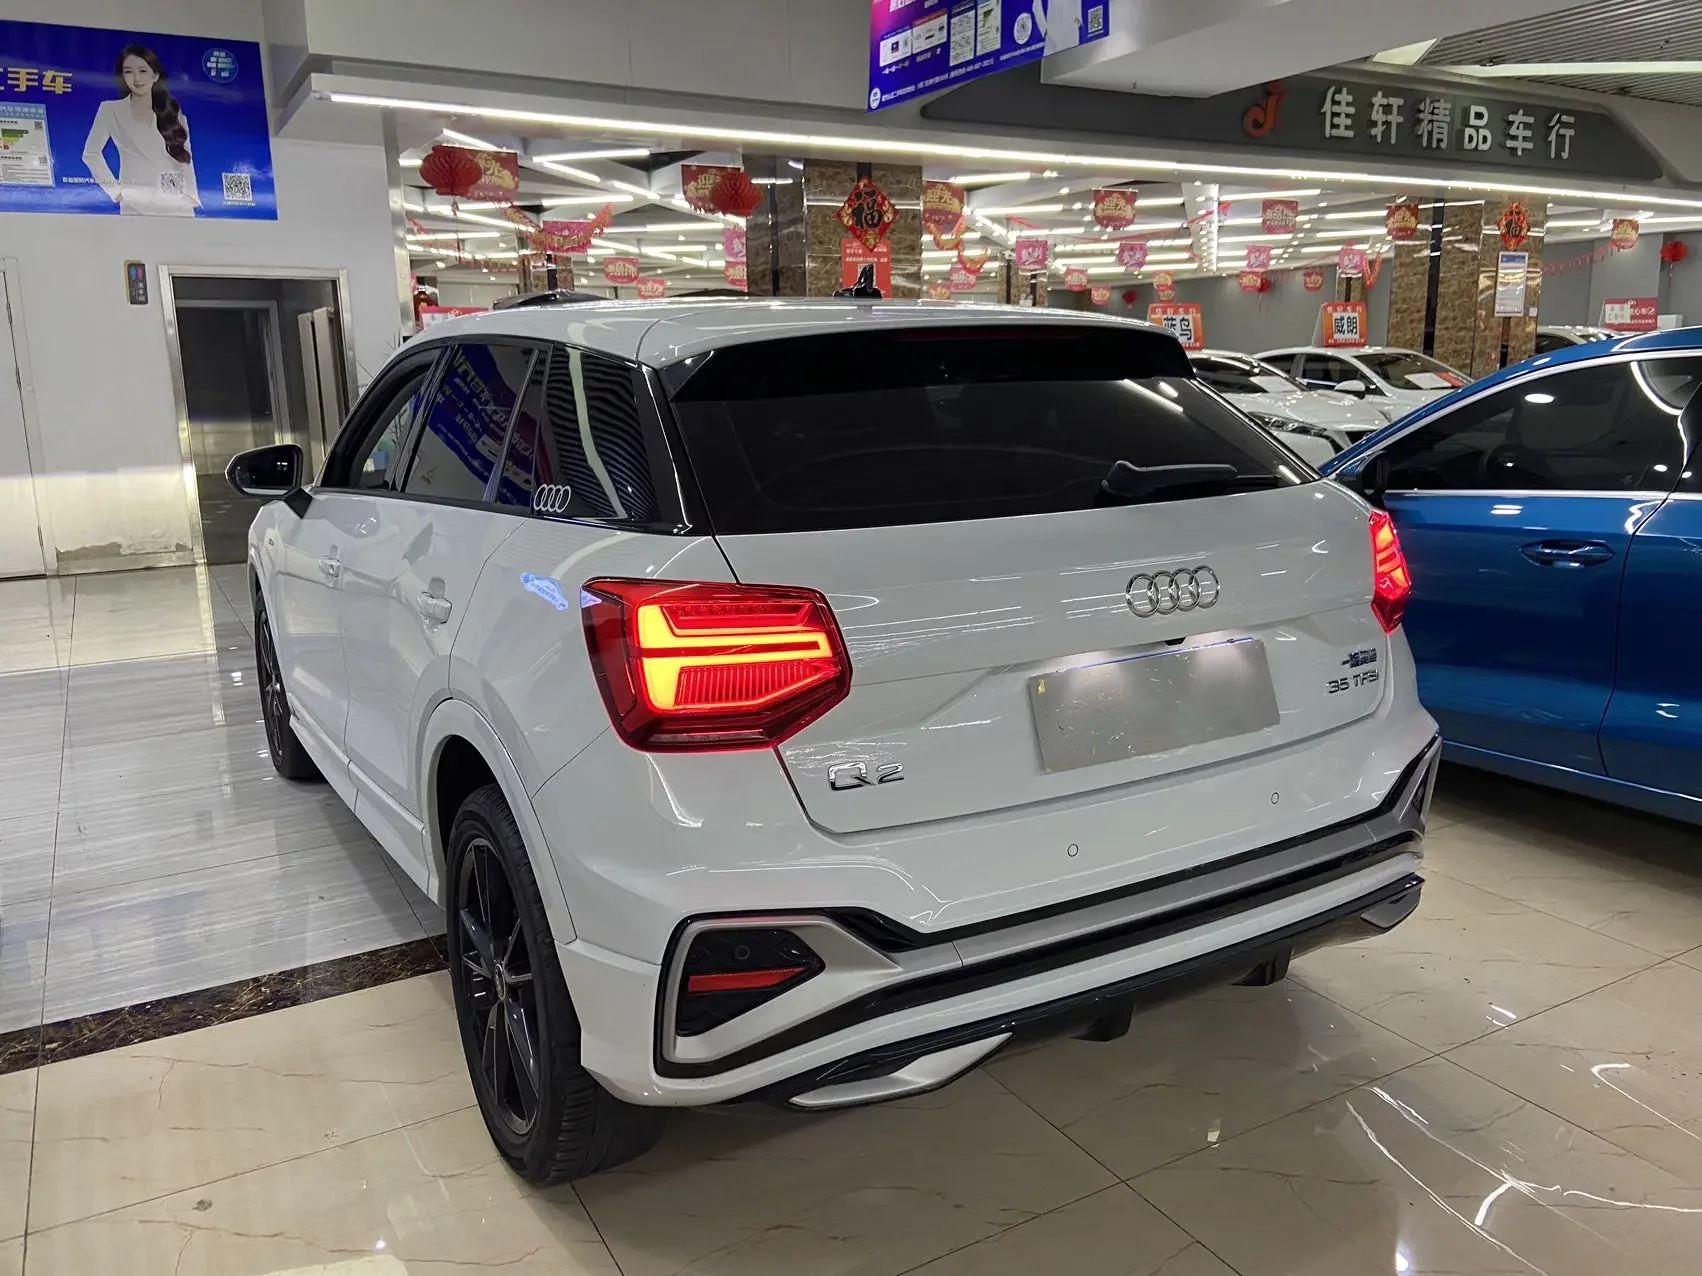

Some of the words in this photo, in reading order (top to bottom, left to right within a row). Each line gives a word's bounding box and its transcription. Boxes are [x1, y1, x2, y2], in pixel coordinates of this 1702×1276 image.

[0, 67, 72, 94] 手车
[1320, 86, 1576, 160] 佳轩精品车行
[852, 188, 883, 230] 福
[1163, 316, 1193, 341] 蓝鸟
[1334, 315, 1358, 336] 威朗
[1326, 677, 1350, 694] 35
[827, 760, 905, 791] Q2
